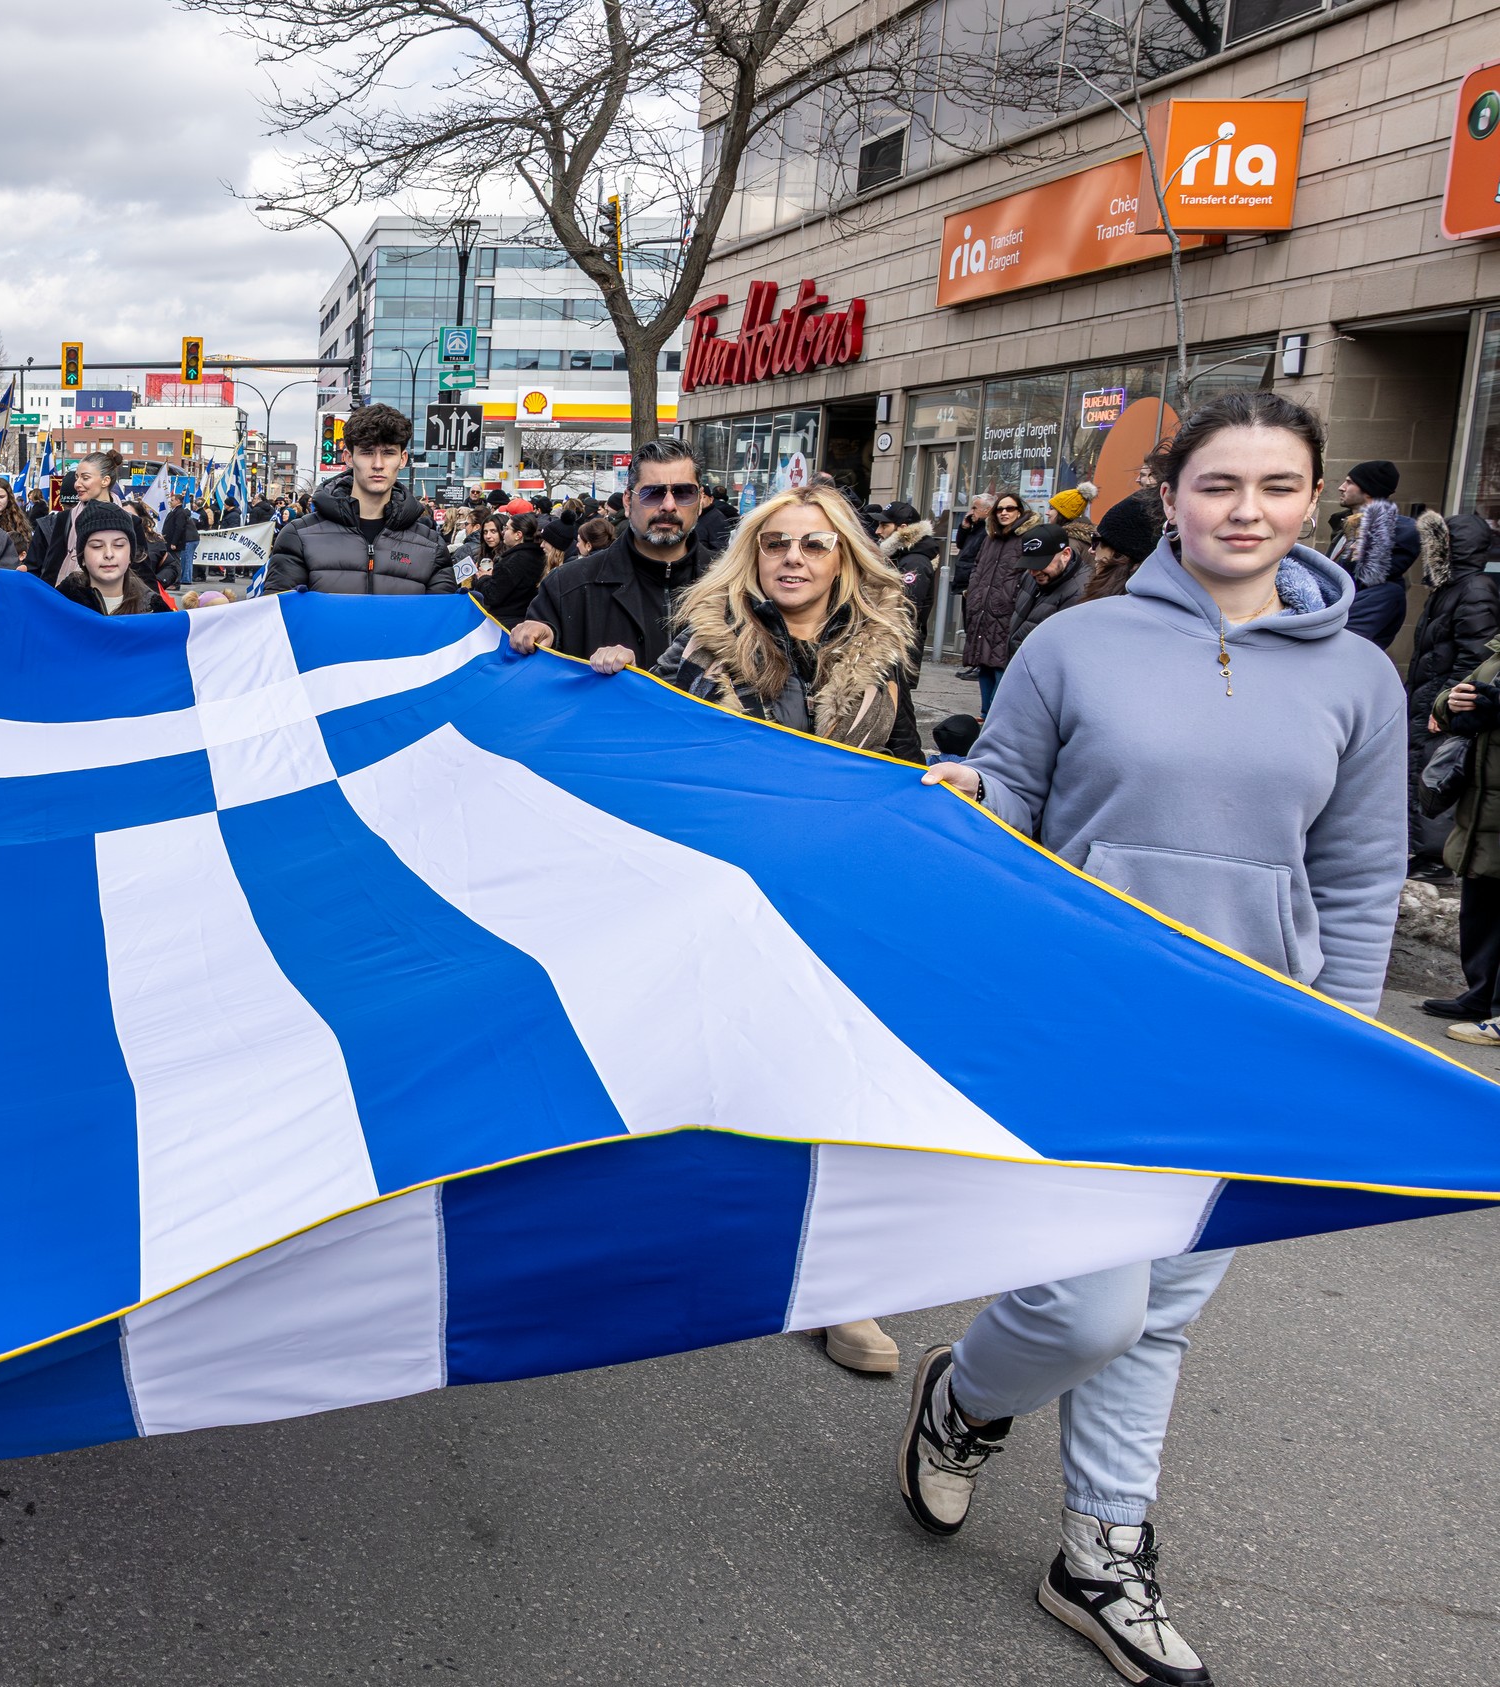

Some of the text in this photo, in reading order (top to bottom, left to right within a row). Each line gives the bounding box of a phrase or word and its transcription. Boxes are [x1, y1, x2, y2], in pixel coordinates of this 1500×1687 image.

[1180, 121, 1277, 186] ria
[1179, 194, 1273, 206] Transfert d'argent
[990, 228, 1023, 250] Transfert
[948, 224, 987, 281] ria
[987, 249, 1021, 272] d'argent
[682, 279, 867, 392] Tim Hortons
[1084, 394, 1123, 408] BUREAU DE
[937, 407, 954, 422] 412
[1087, 409, 1118, 422] CHANGE
[984, 422, 1057, 443] Envoyer de l'argent
[982, 444, 1052, 461] à travers le monde
[229, 531, 239, 541] DE
[238, 534, 267, 560] MONTREAL
[202, 552, 241, 561] FERAIOS
